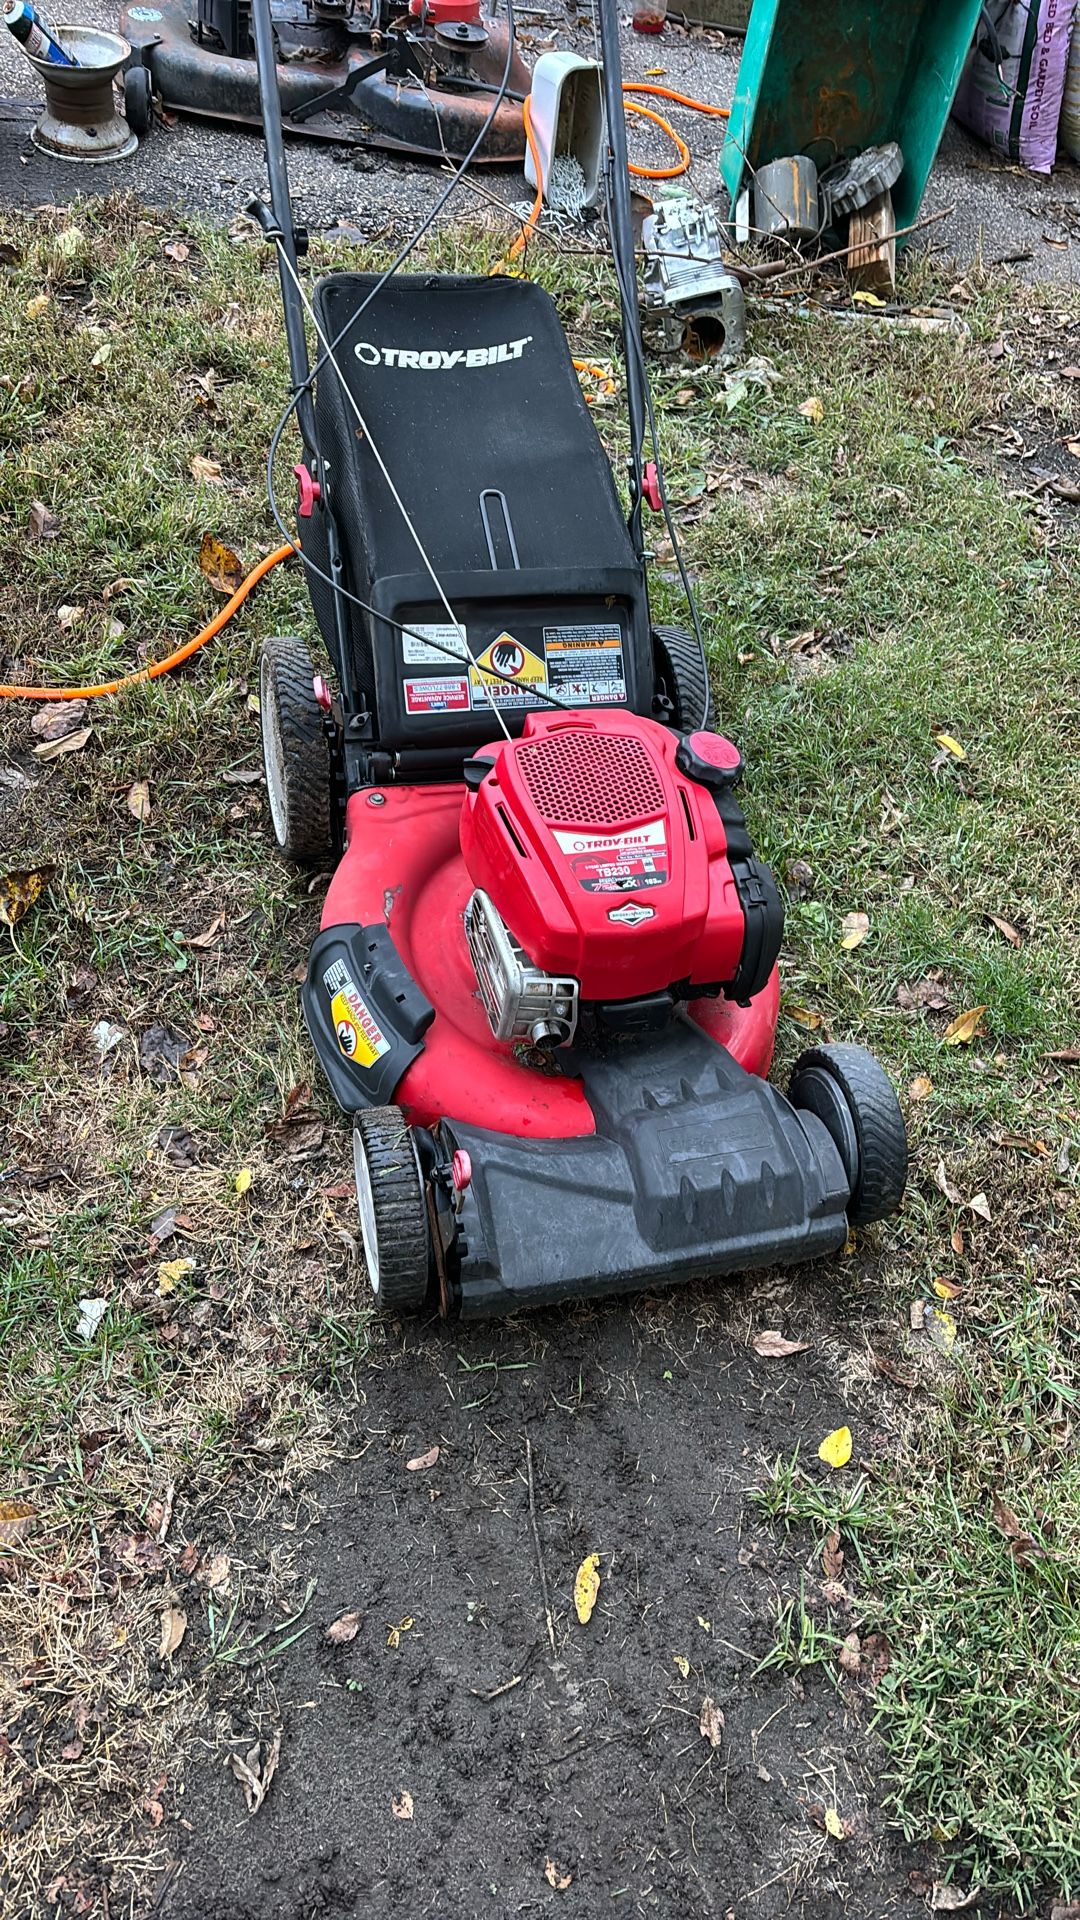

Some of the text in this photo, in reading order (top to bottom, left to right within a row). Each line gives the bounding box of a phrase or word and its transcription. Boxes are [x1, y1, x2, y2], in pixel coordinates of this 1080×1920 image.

[1043, 22, 1055, 44] BED
[1029, 105, 1040, 130] SOIL
[381, 337, 528, 369] TROY-BILT
[411, 695, 442, 703] ADVANTAGE
[586, 835, 650, 849] TROY-BILT
[596, 865, 631, 877] TB230
[348, 992, 382, 1045] DANGER
[366, 1040, 378, 1057] AWAY
